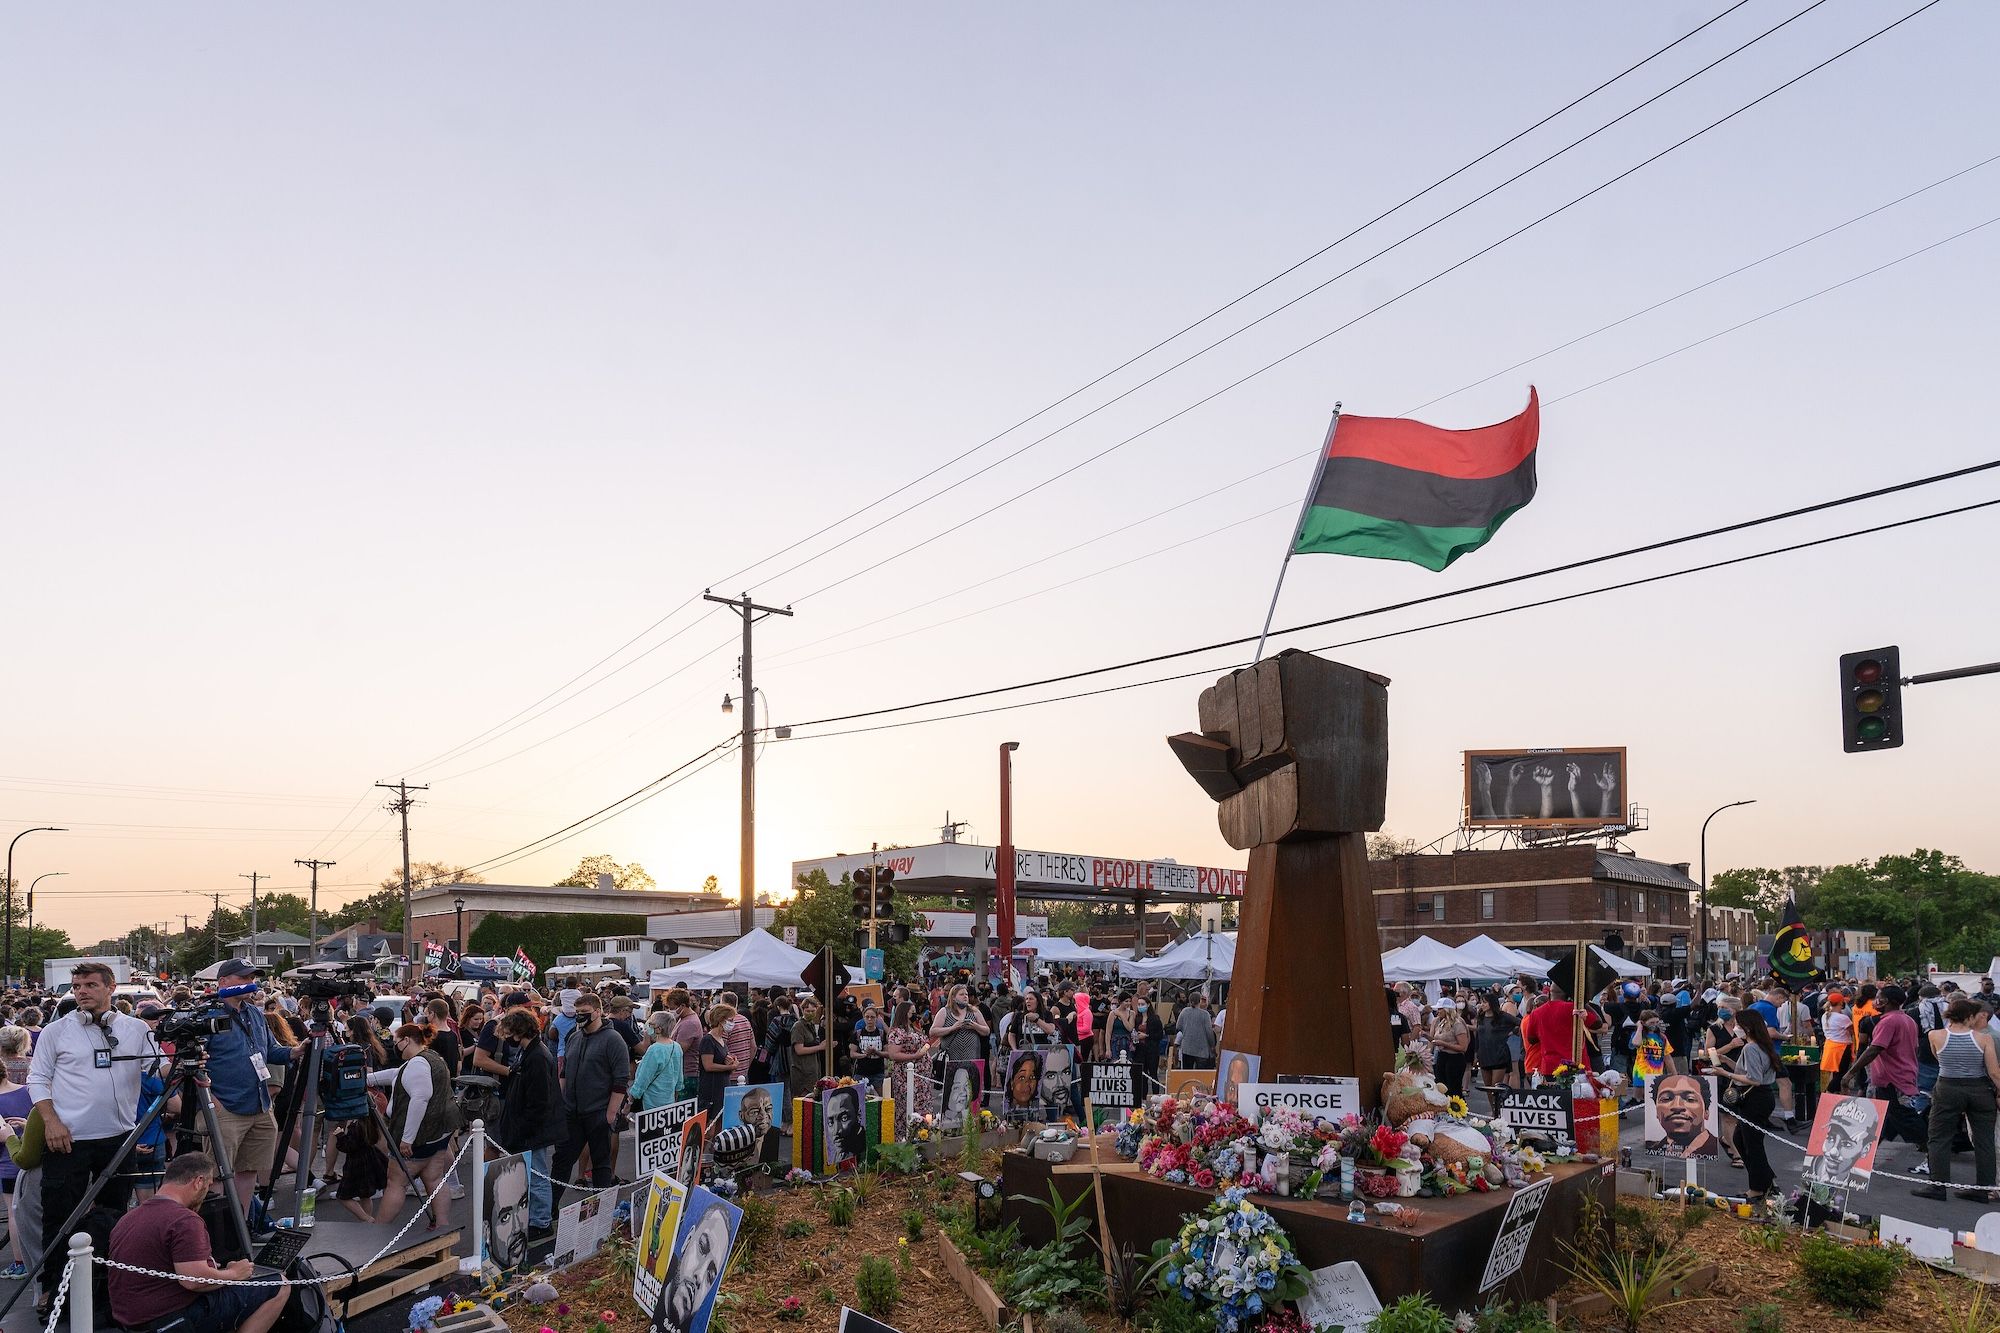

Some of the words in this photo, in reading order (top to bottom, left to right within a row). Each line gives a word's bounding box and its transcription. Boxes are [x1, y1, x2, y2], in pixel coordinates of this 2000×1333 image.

[1093, 859, 1154, 890] PEOPLE
[1092, 1065, 1132, 1078] BLACK
[1096, 1081, 1128, 1092] LIVES
[1089, 1093, 1134, 1106] MATTER
[1255, 1092, 1342, 1109] GEORGE
[1504, 1094, 1562, 1110] BLACK
[641, 1103, 692, 1134] JUSTICE
[1510, 1111, 1557, 1126] LIVES
[1833, 1102, 1867, 1123] CHICAGO
[663, 1126, 672, 1136] for
[1601, 1164, 1616, 1175] LOVE
[1506, 1185, 1547, 1223] JUSTICE
[1495, 1223, 1532, 1257] GEORGE
[1489, 1248, 1520, 1281] FLOYD
